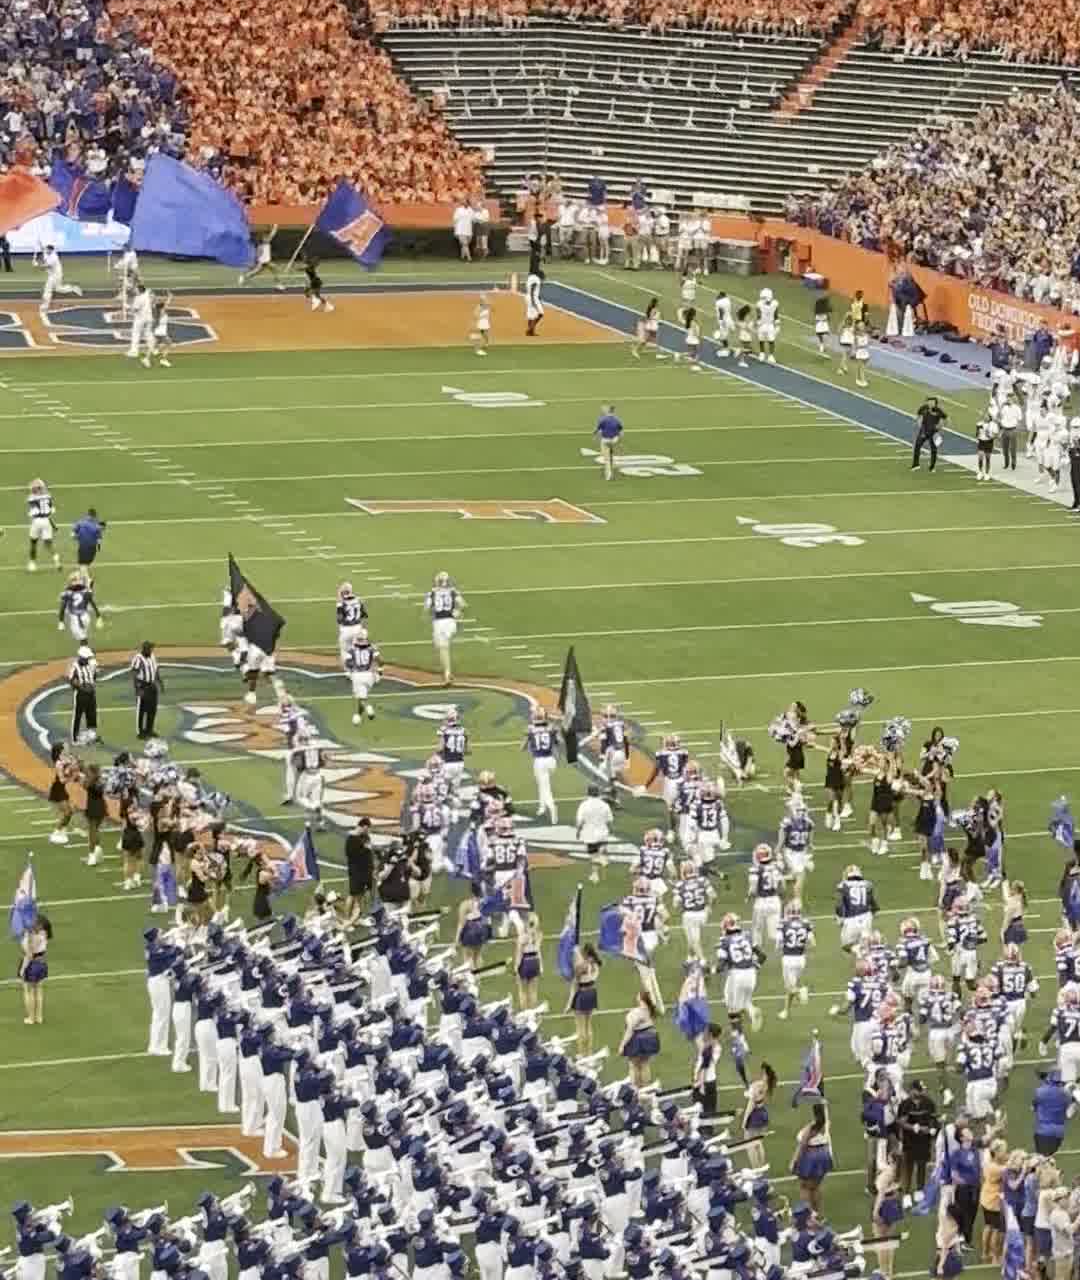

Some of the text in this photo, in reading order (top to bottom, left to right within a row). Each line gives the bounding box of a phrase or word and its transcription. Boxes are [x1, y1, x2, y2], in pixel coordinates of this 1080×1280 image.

[785, 928, 808, 948] 32
[729, 941, 752, 962] 63
[970, 1047, 993, 1069] 33
